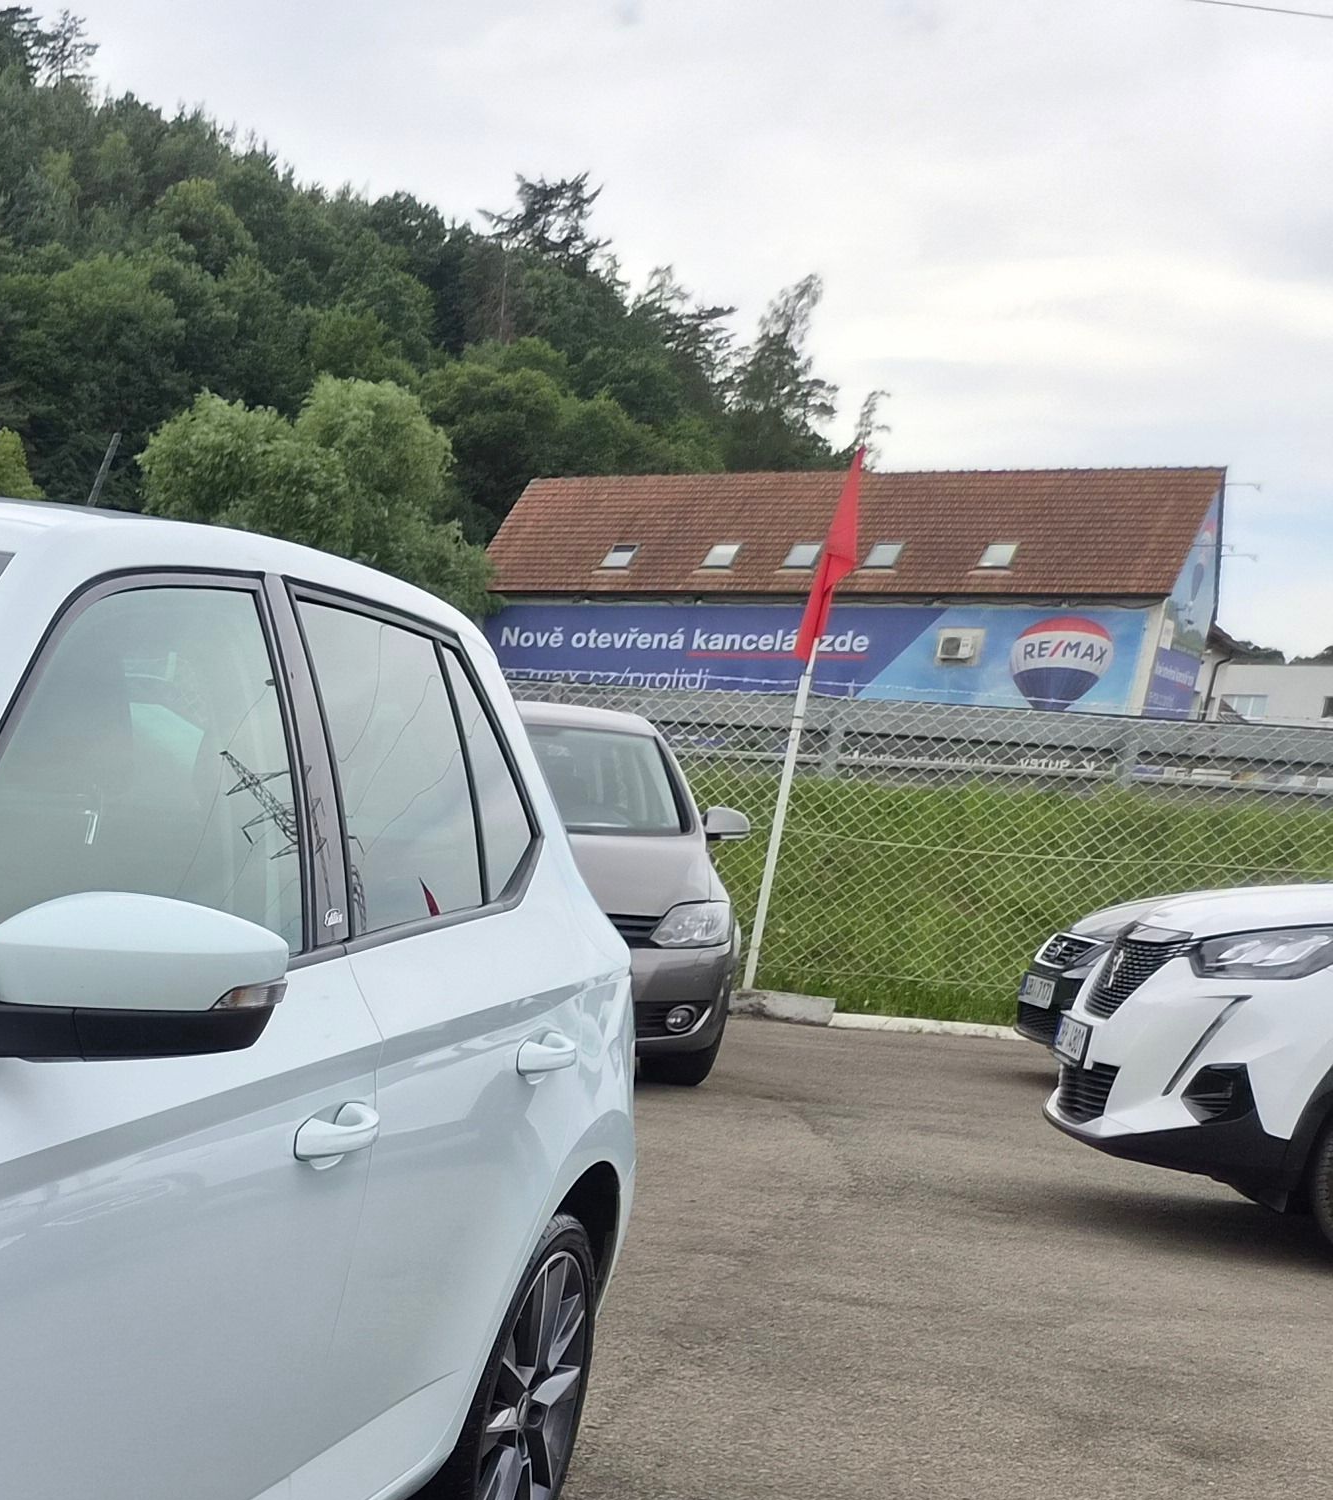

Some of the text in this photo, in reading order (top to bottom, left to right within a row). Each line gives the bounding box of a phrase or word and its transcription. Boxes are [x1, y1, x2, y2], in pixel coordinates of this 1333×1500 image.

[500, 626, 870, 653] Nově otevřená kancelá zde
[1023, 640, 1108, 666] RE/MAX
